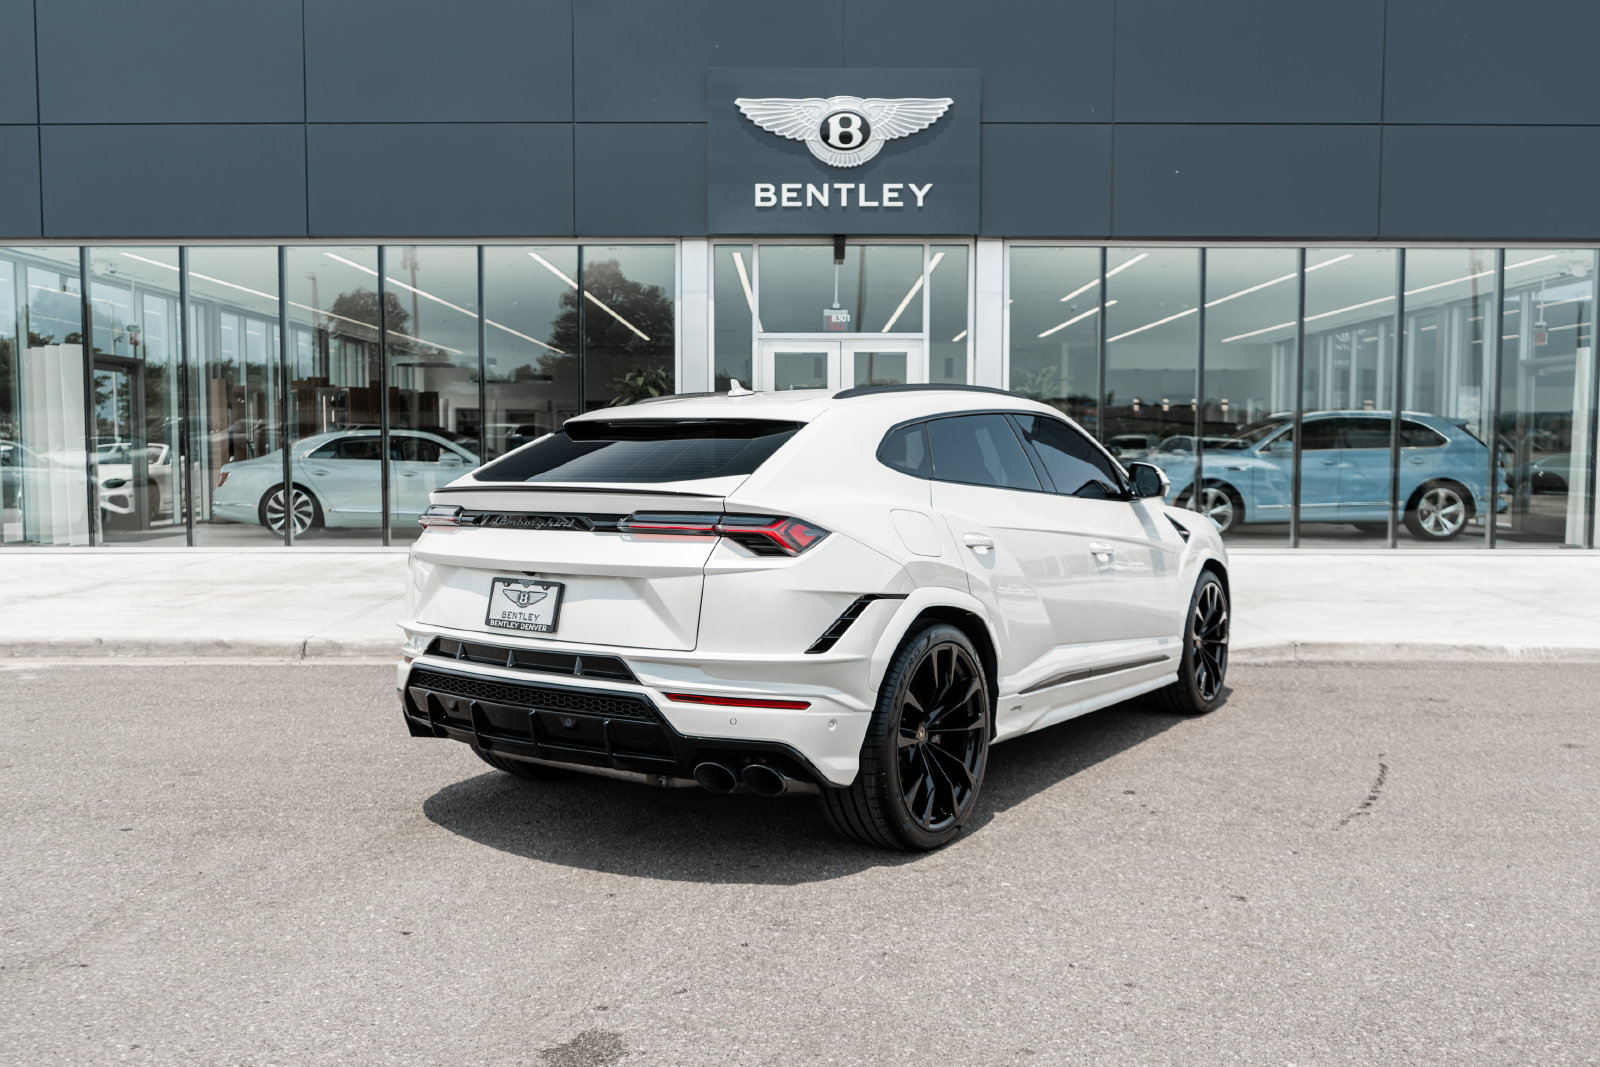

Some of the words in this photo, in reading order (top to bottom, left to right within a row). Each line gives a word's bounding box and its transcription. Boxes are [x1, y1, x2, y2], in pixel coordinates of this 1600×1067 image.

[828, 112, 863, 148] B
[754, 183, 933, 207] BENTLEY
[831, 314, 850, 322] 8301
[501, 610, 540, 622] BENTLEY
[490, 619, 519, 629] BENTLEY
[520, 623, 547, 632] DENVER
